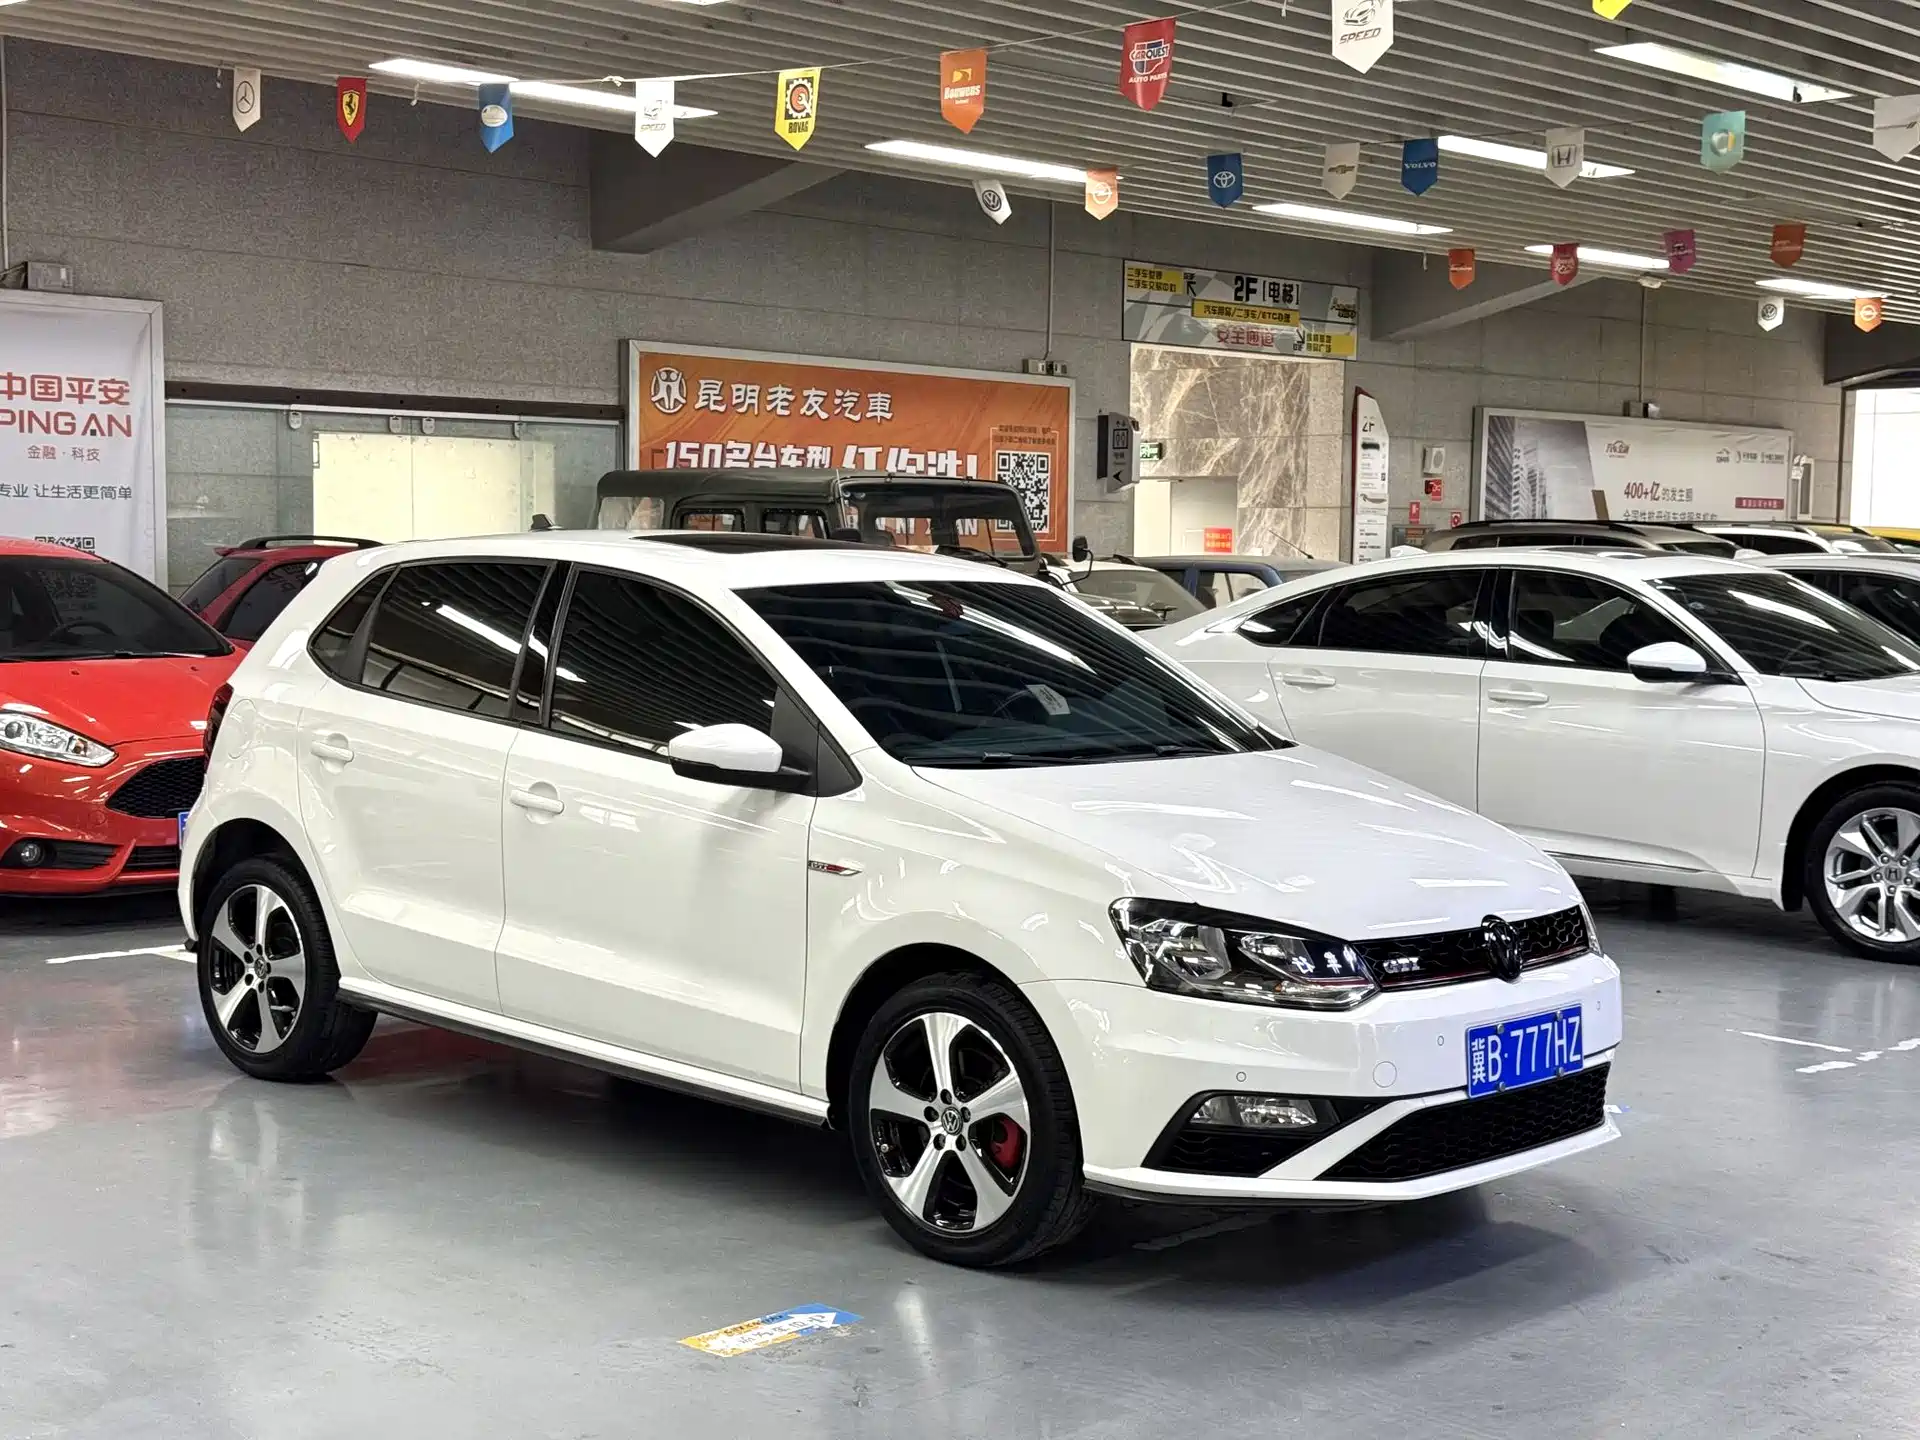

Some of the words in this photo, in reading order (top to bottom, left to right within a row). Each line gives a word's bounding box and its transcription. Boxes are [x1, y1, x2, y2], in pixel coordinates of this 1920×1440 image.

[1340, 27, 1381, 44] SPEED
[1404, 161, 1437, 169] VOLVO
[1234, 275, 1258, 302] 2F
[0, 372, 130, 406] 中国平安
[34, 484, 132, 501] 让生活更简单
